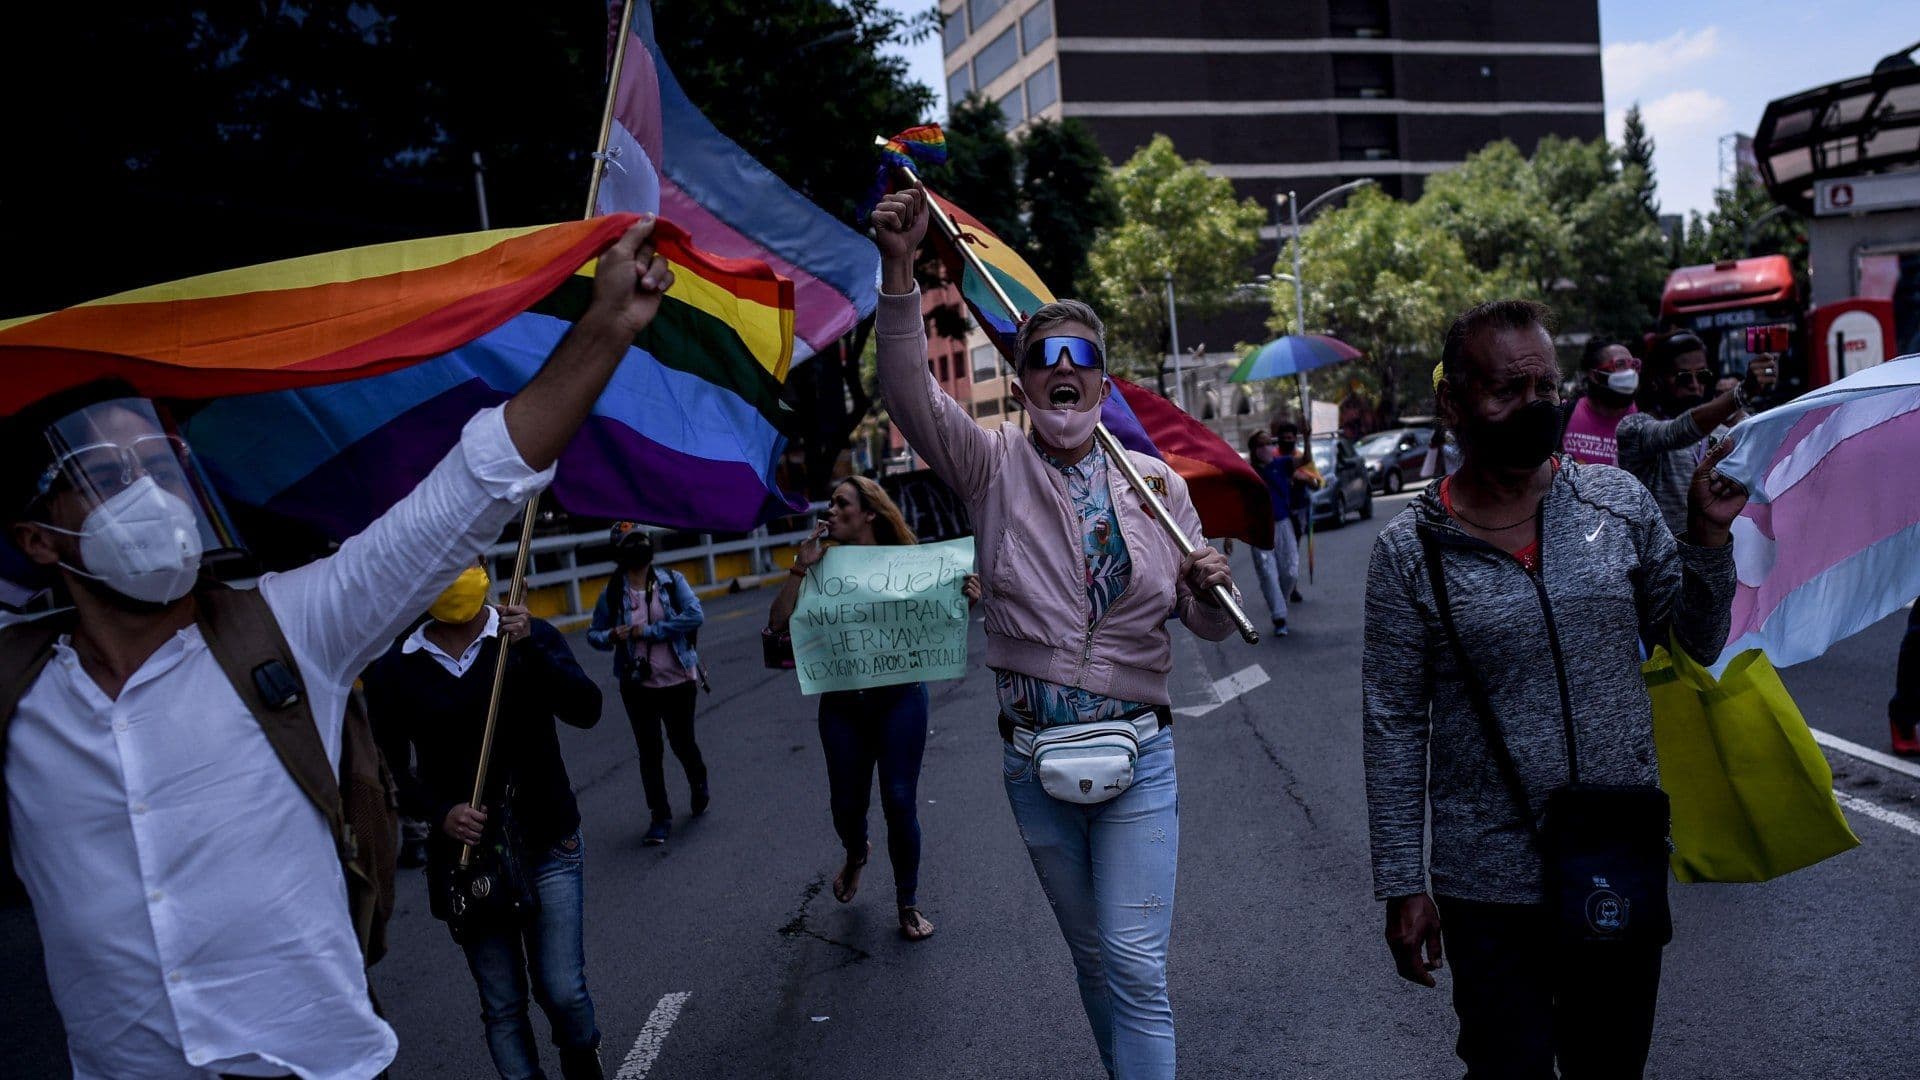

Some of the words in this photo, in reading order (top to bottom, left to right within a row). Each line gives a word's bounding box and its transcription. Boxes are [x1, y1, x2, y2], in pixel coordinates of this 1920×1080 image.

[803, 558, 858, 597] Nos
[828, 624, 945, 656] HERMANAS
[873, 652, 907, 674] APOYO
